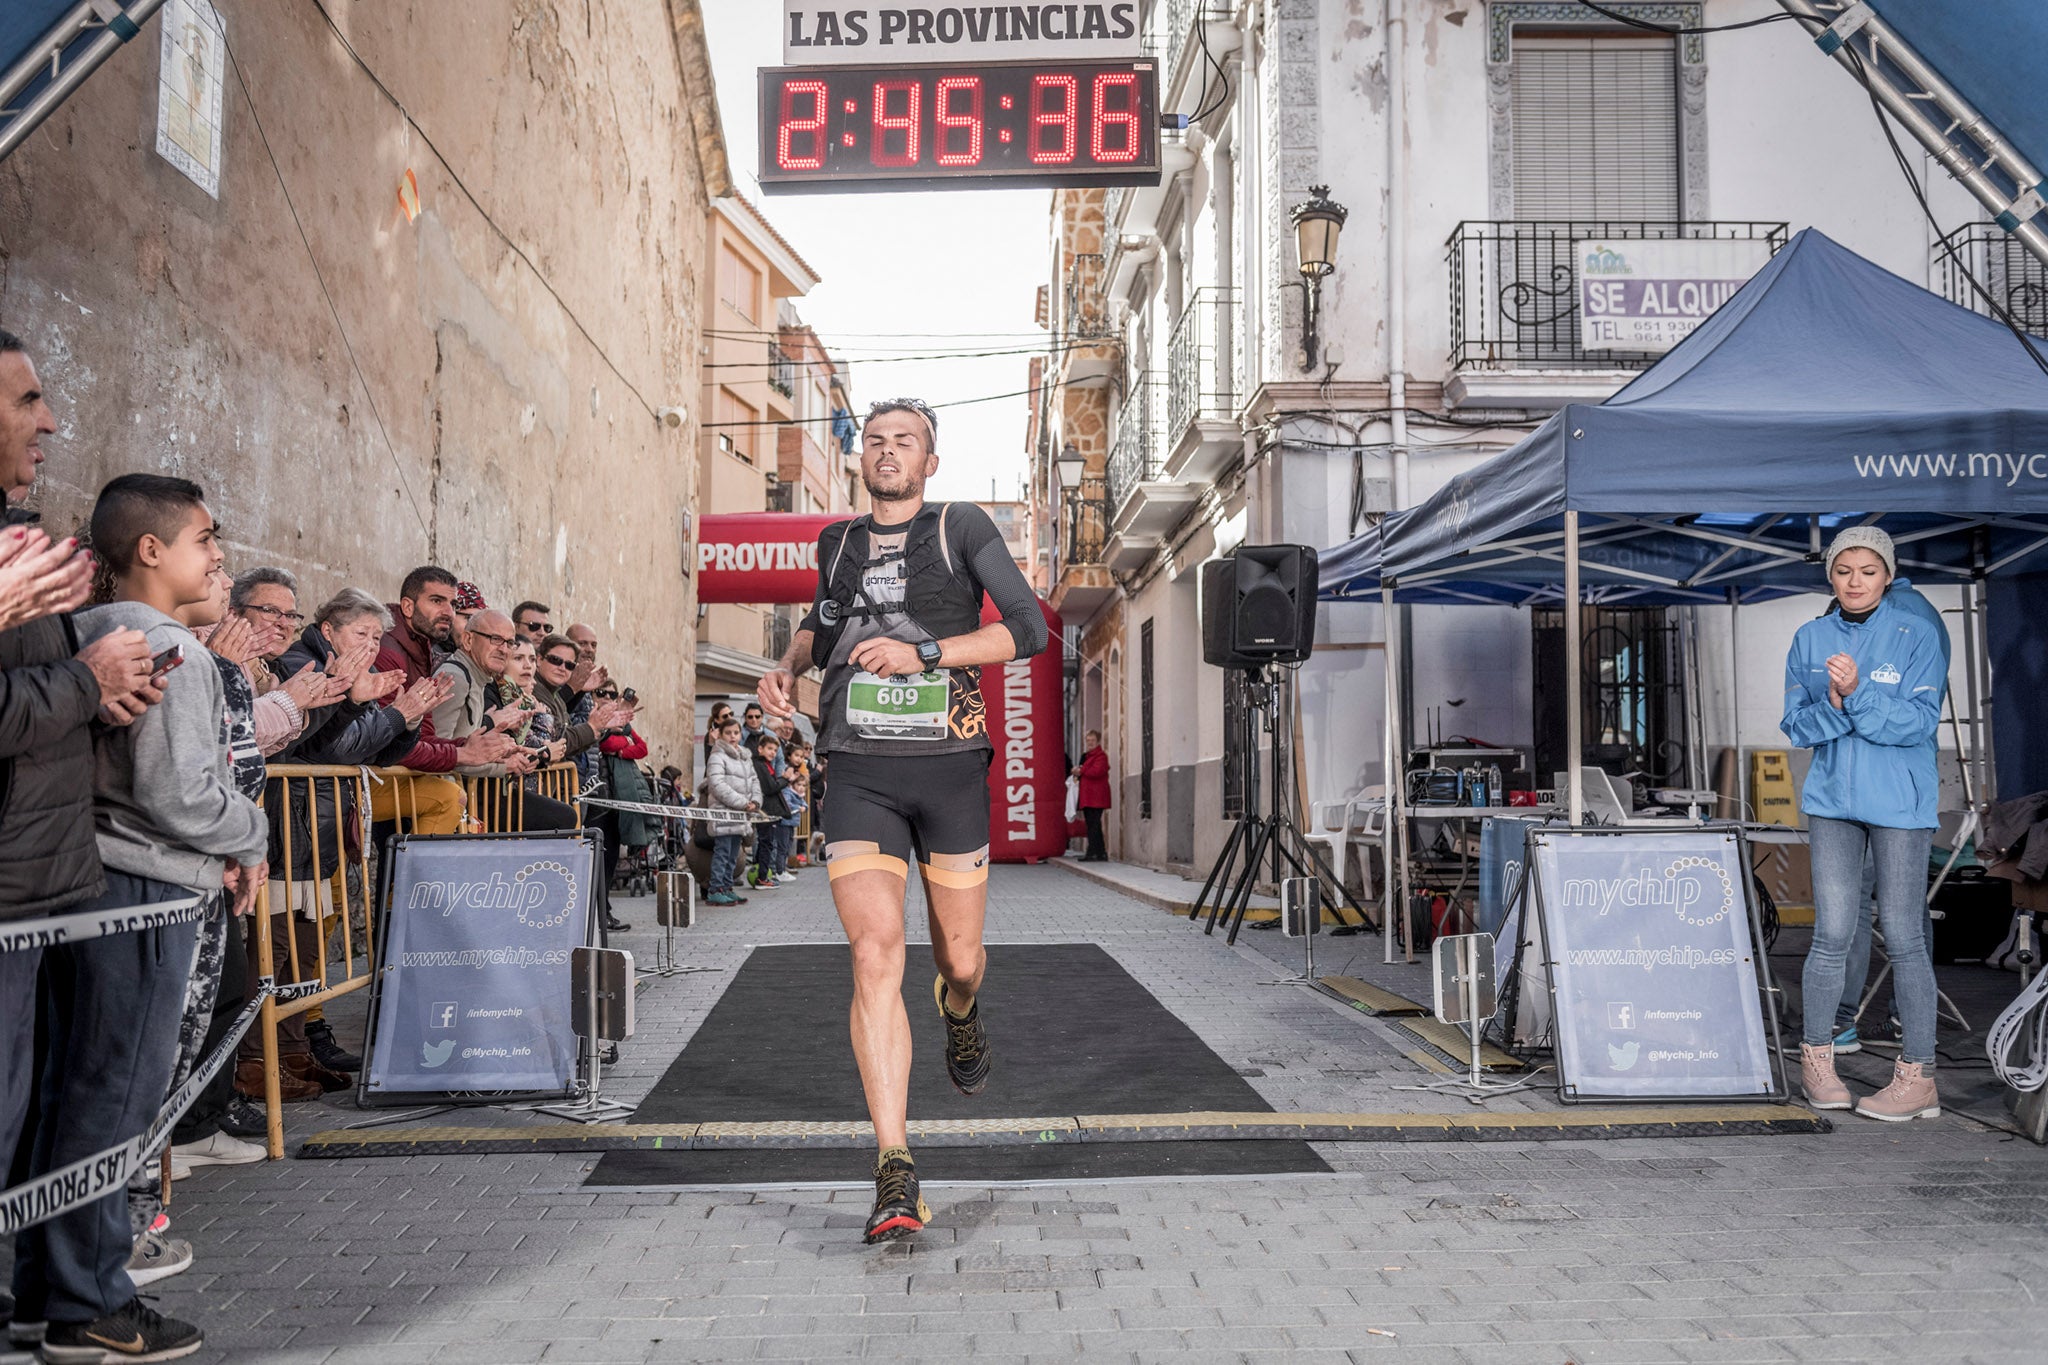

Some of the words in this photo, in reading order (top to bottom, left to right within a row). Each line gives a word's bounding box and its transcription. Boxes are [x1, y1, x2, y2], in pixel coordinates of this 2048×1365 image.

[789, 9, 868, 47] LAS
[879, 2, 1135, 45] PROVINCIAS
[1588, 282, 1626, 314] SE
[1854, 453, 2047, 487] www.myc
[877, 687, 919, 706] 609
[1007, 784, 1036, 841] LAS
[408, 871, 547, 917] mychip
[1562, 868, 1701, 915] mychip
[402, 946, 568, 968] www.mychip.es
[1567, 945, 1736, 969] www.mychip.es
[466, 1007, 523, 1019] /infomychip
[1644, 1009, 1702, 1021] /infomychip
[461, 1046, 531, 1059] @Mychip_Info
[1648, 1050, 1719, 1062] @Mychip_Info
[93, 1146, 128, 1193] LAS
